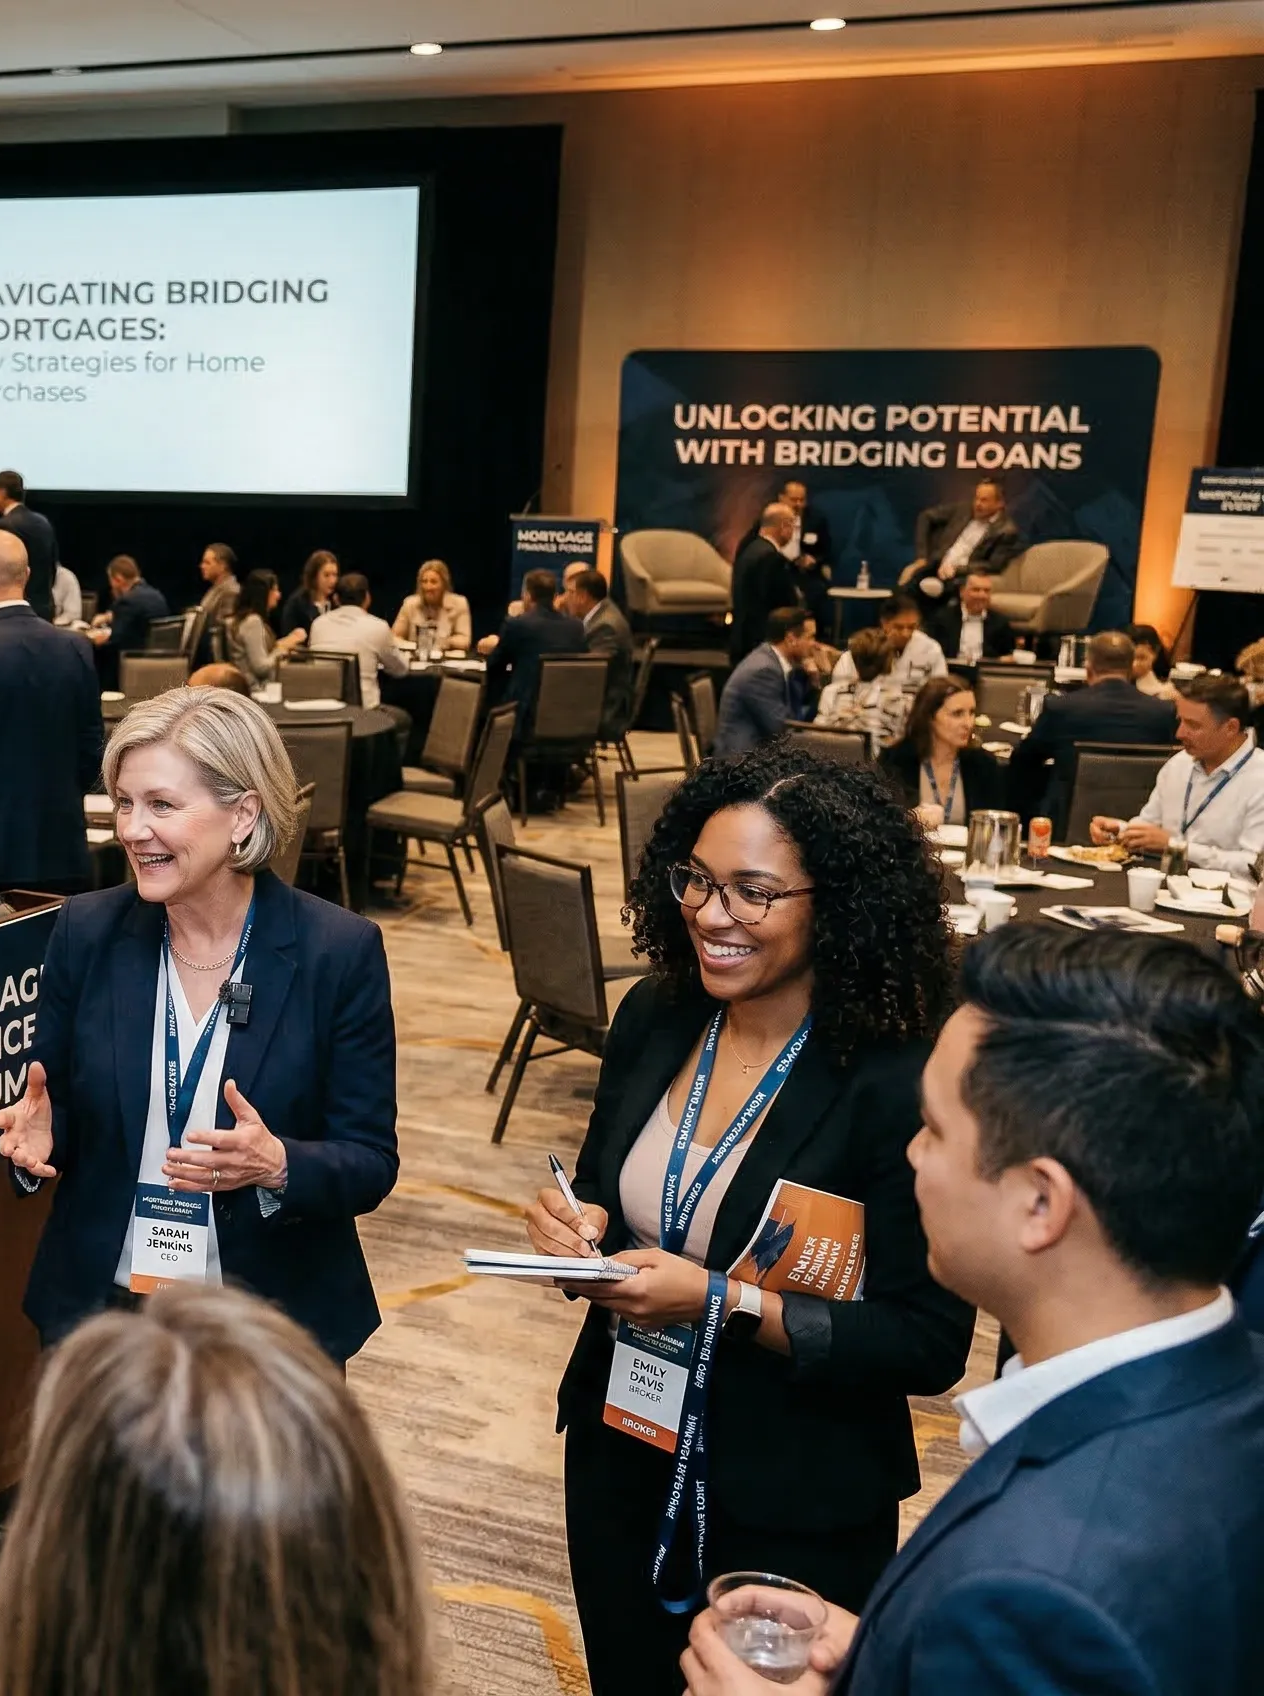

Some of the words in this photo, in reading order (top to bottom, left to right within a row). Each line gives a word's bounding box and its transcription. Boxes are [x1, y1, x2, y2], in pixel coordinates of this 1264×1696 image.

[167, 279, 329, 304] BRIDGING
[11, 350, 137, 378] Strategies
[144, 350, 178, 373] for
[187, 352, 266, 373] Home
[674, 403, 877, 432] UNLOCKING
[886, 404, 1091, 434] POTENTIAL
[674, 438, 766, 466] WITH
[774, 440, 947, 469] BRIDGING
[956, 441, 1083, 470] LOANS
[151, 1226, 190, 1240] SARAH
[160, 1252, 179, 1262] CEO
[633, 1358, 667, 1379] EMILY
[630, 1371, 665, 1393] DAVIS
